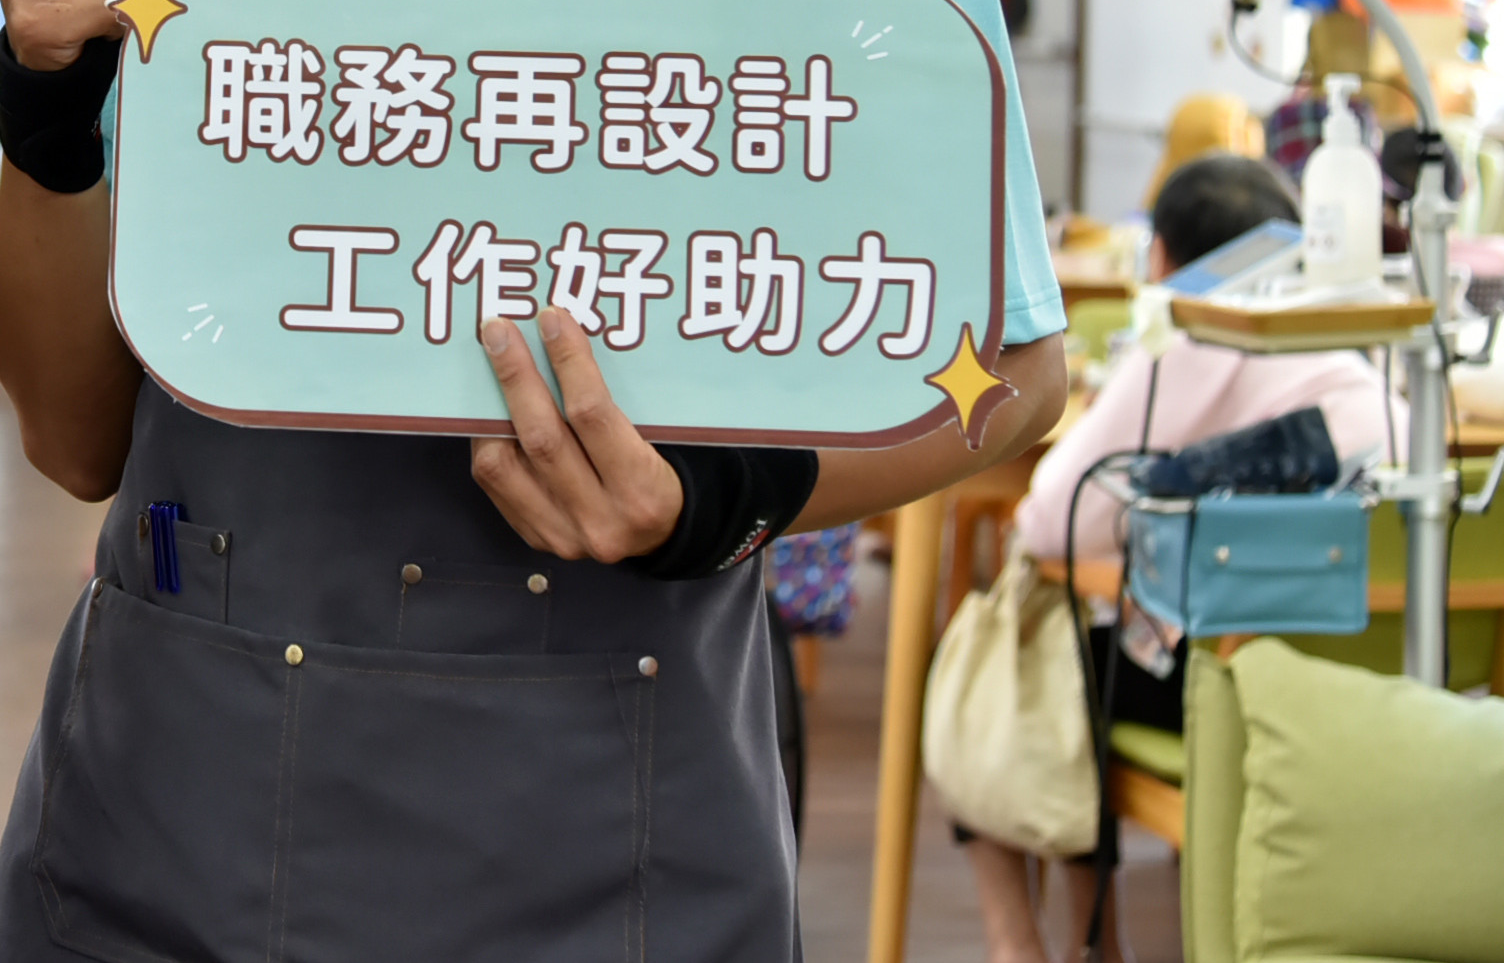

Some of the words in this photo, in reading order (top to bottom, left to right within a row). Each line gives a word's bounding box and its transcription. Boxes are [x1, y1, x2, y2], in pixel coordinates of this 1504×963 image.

[198, 37, 857, 181] 職務再設計
[280, 219, 937, 360] 工作好助力
